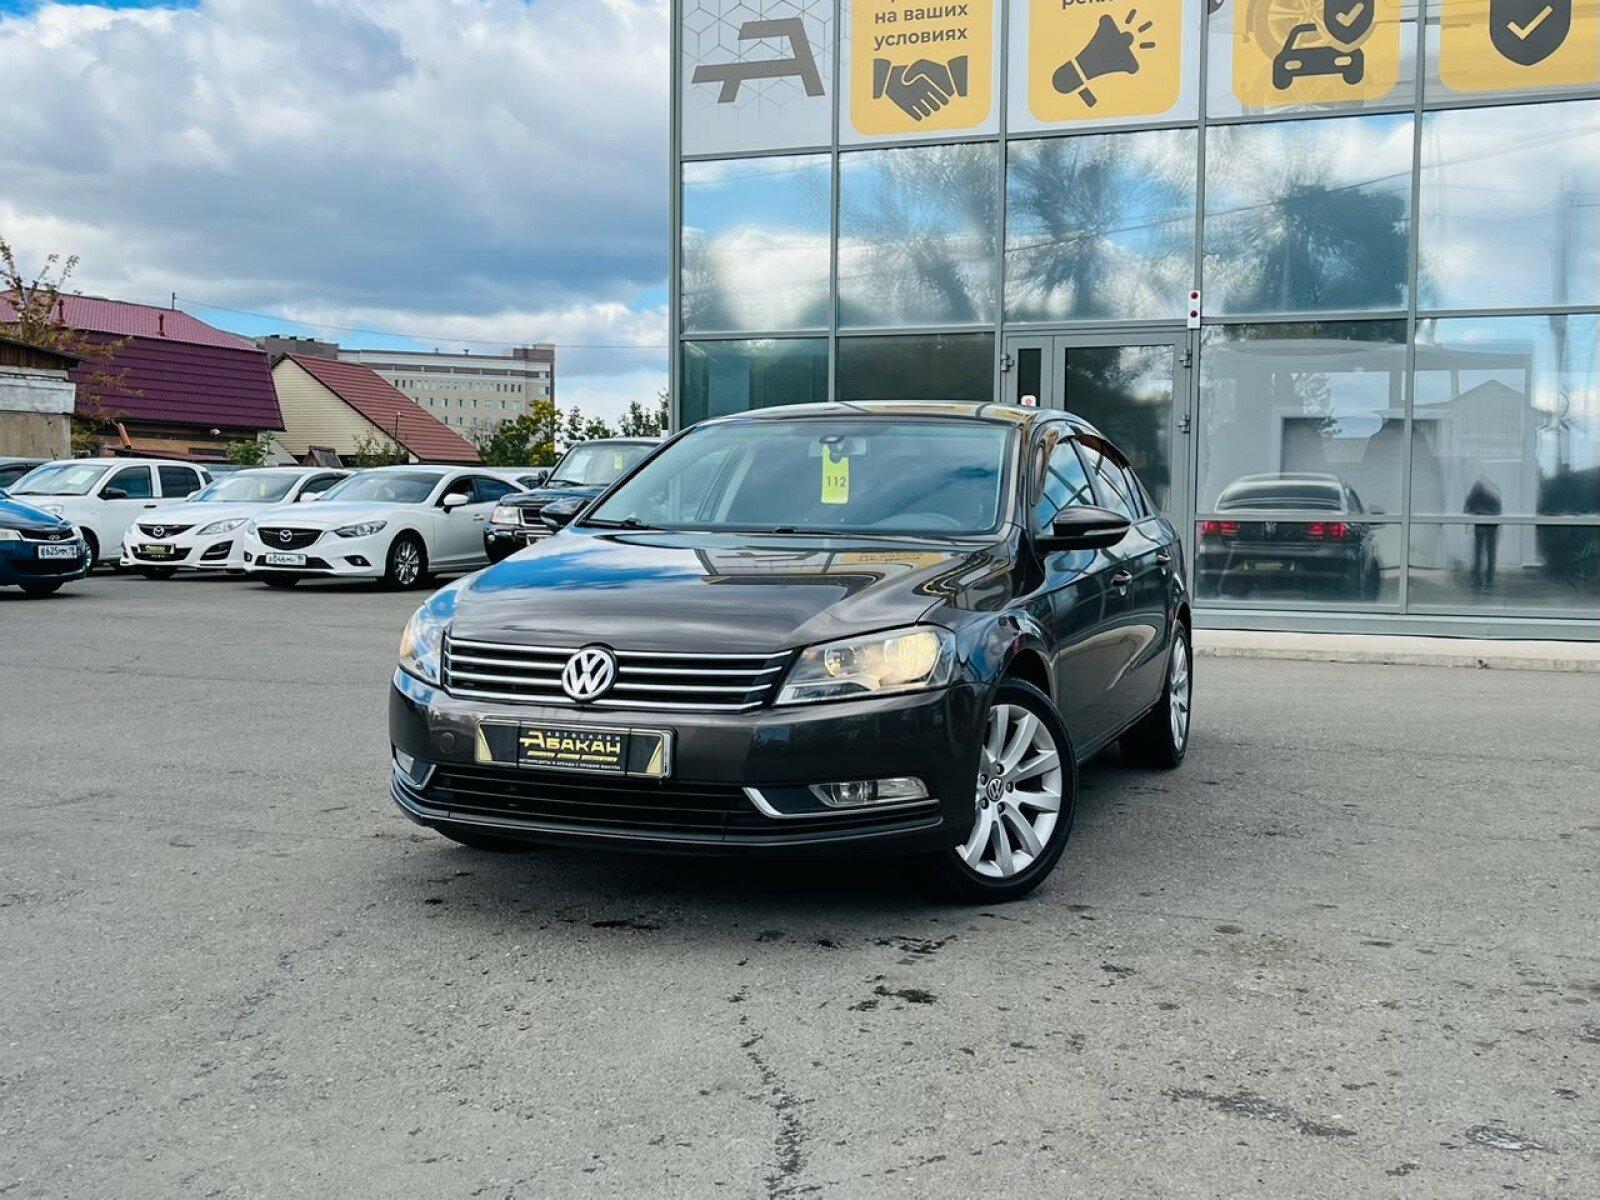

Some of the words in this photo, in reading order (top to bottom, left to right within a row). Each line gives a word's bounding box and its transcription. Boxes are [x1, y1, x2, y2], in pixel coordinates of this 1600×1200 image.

[874, 11, 898, 24] на
[904, 4, 968, 21] ваших
[873, 28, 968, 51] условиях
[826, 476, 847, 487] 112
[561, 649, 615, 700] VW
